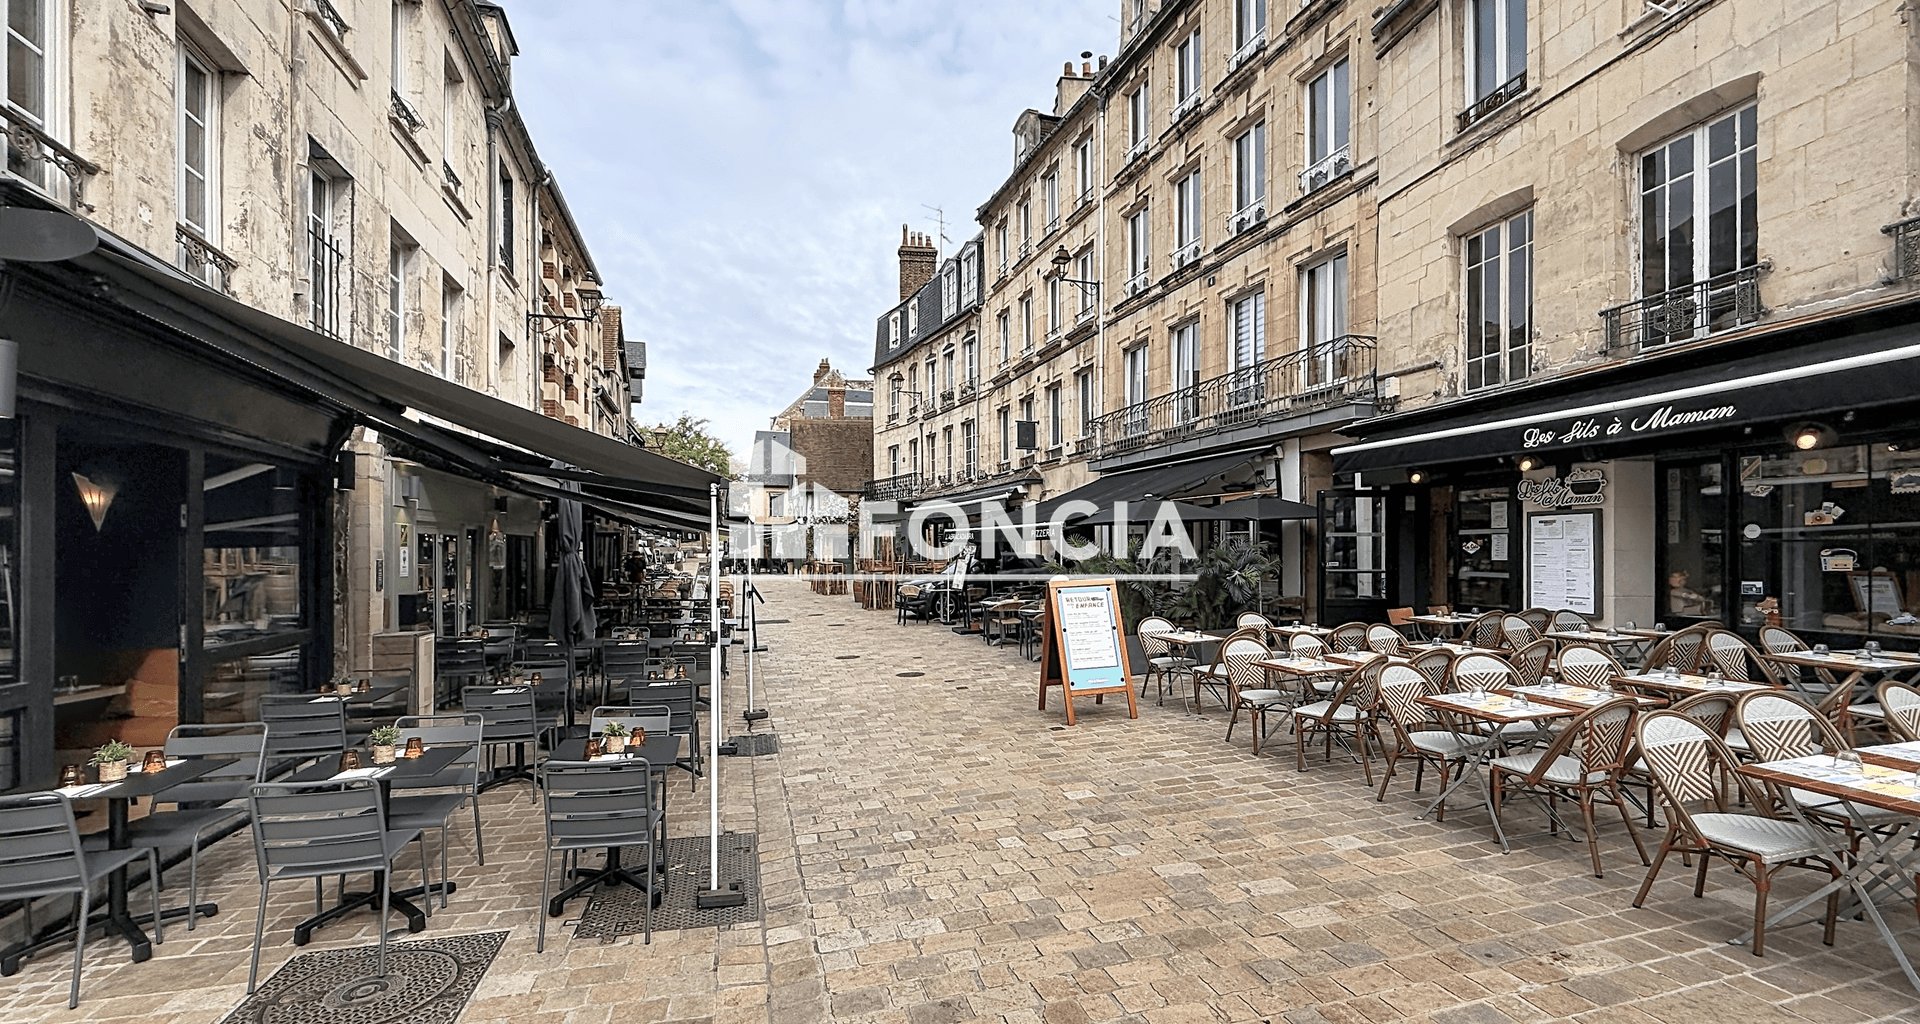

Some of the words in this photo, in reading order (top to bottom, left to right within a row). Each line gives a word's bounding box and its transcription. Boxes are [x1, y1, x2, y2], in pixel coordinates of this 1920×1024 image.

[1523, 428, 1555, 448] Les
[1558, 418, 1600, 443] fils
[1606, 416, 1623, 436] à
[1631, 405, 1737, 432] Maman
[1518, 480, 1541, 499] Les
[1533, 478, 1561, 503] fils
[1542, 489, 1603, 507] Maman
[1031, 528, 1056, 538] PIZZERIA
